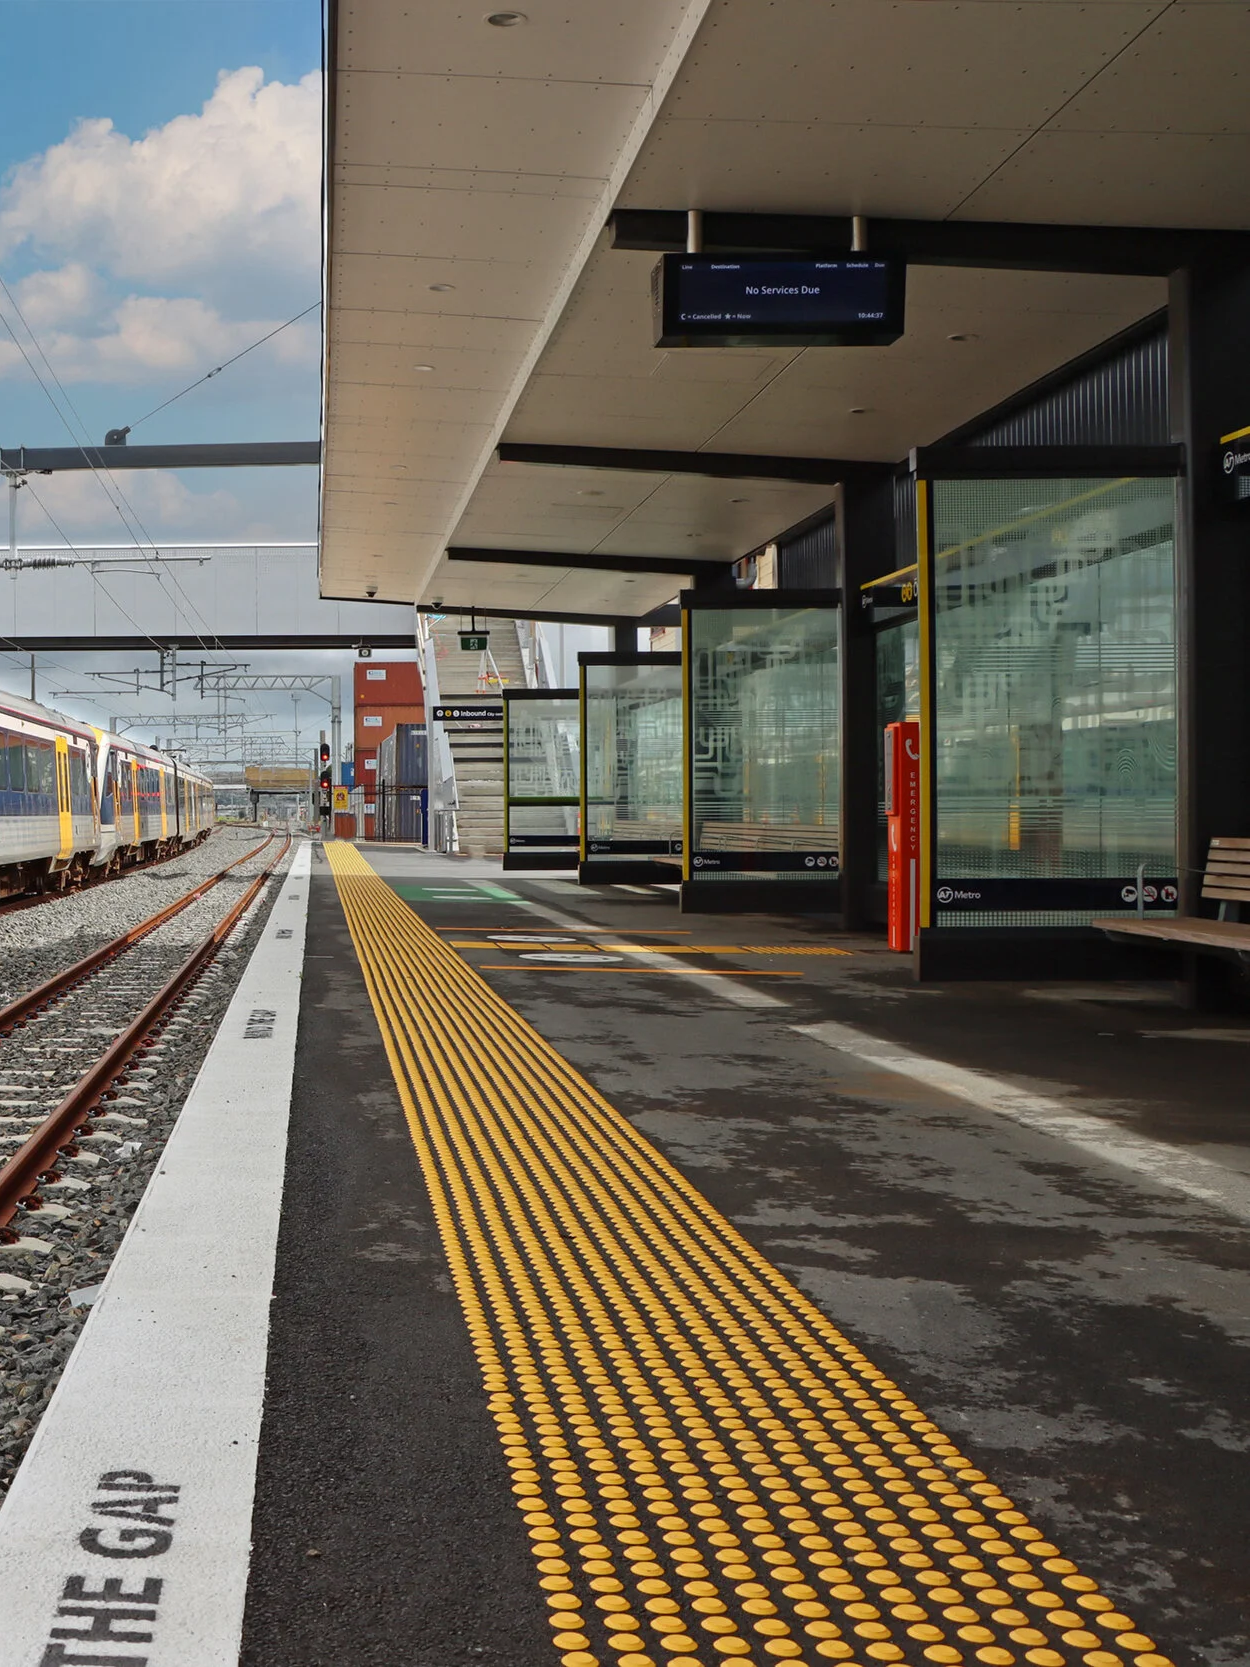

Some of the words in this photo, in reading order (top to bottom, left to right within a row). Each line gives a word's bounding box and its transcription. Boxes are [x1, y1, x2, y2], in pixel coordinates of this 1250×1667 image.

[745, 286, 759, 295] No
[761, 285, 799, 295] Services
[801, 285, 820, 294] Due
[954, 890, 981, 899] Metro
[79, 1469, 181, 1559] GAP
[40, 1575, 164, 1667] THE
